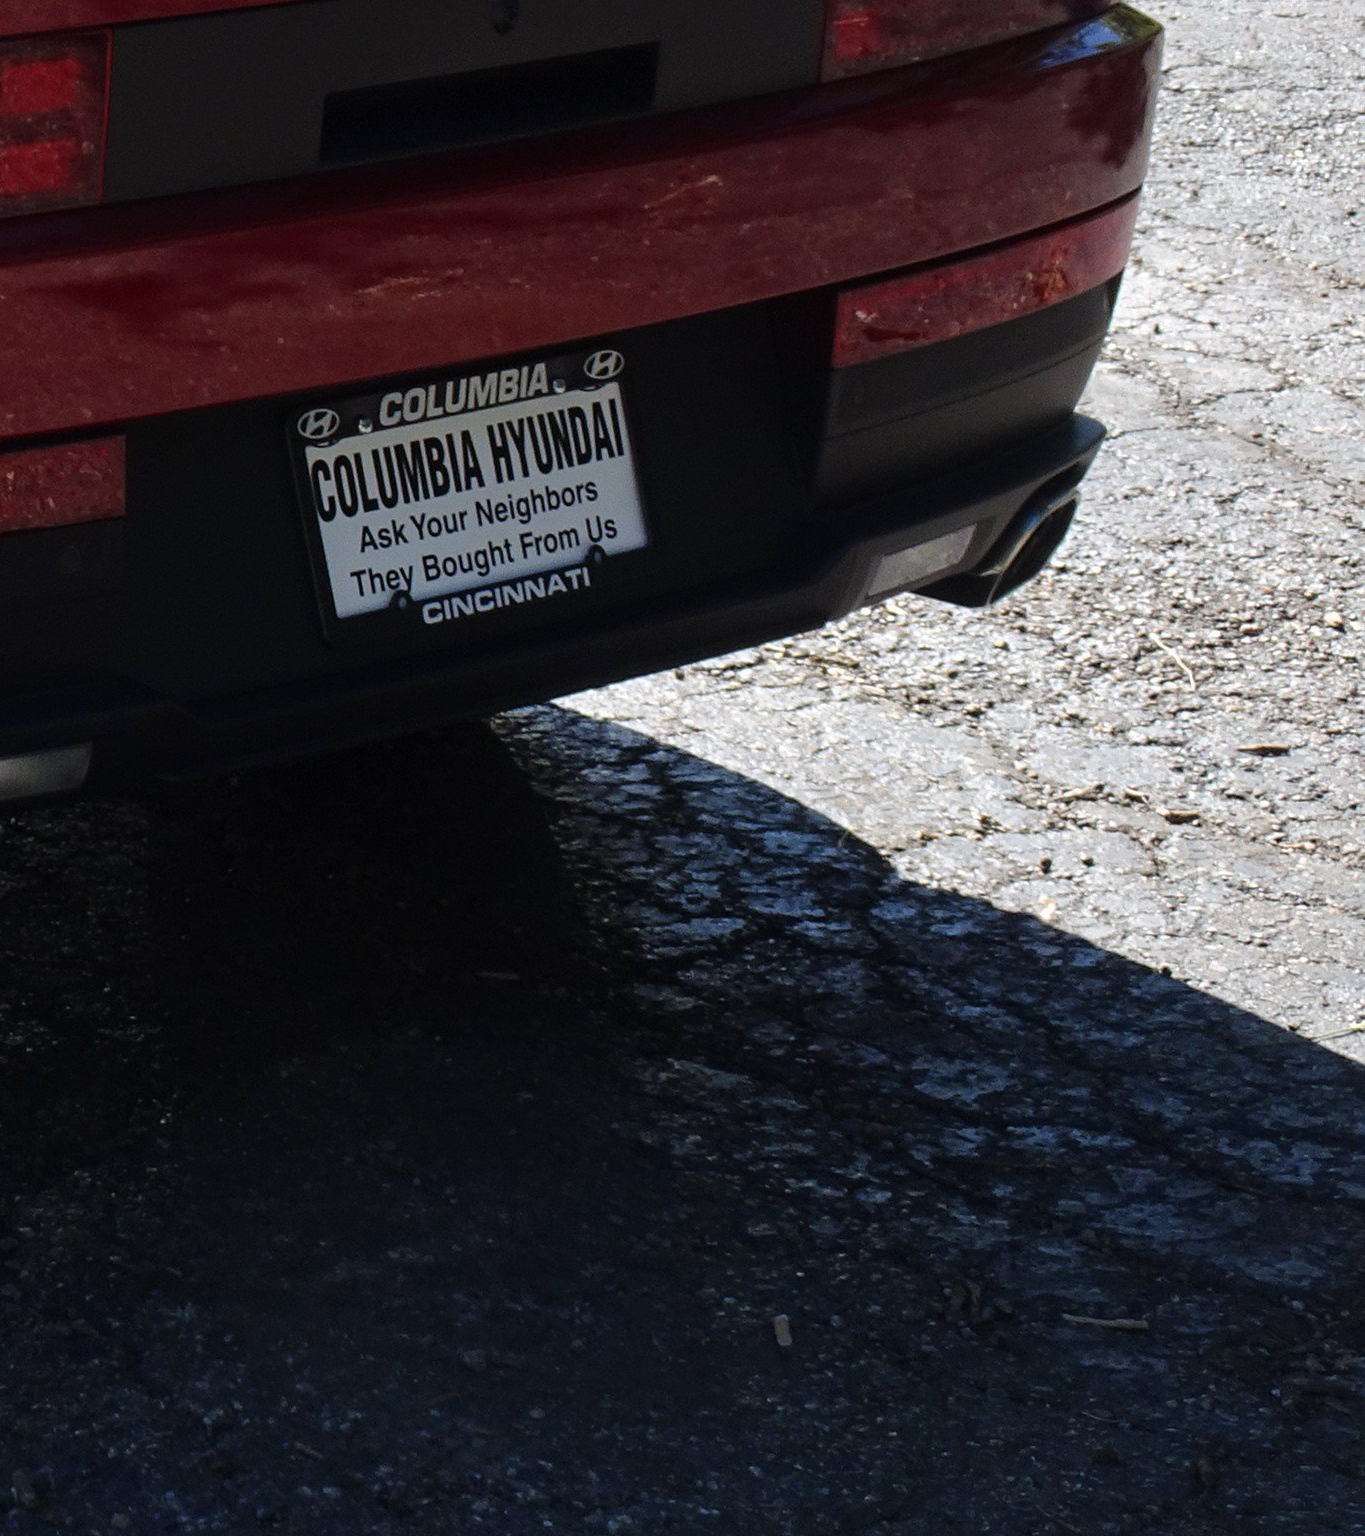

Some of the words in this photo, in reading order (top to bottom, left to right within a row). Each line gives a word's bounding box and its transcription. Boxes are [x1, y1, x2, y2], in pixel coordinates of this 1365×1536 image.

[379, 362, 549, 427] COLUMBIA
[310, 429, 486, 523] COLUMBIA
[487, 397, 625, 485] HYUNDAI
[359, 519, 409, 553] Ask
[410, 506, 468, 539] Your
[475, 478, 599, 528] Neighbors
[350, 563, 414, 600] They
[422, 542, 515, 582] Bought
[519, 526, 580, 560] From
[585, 515, 618, 544] Us
[421, 566, 591, 625] CINCINNATI
